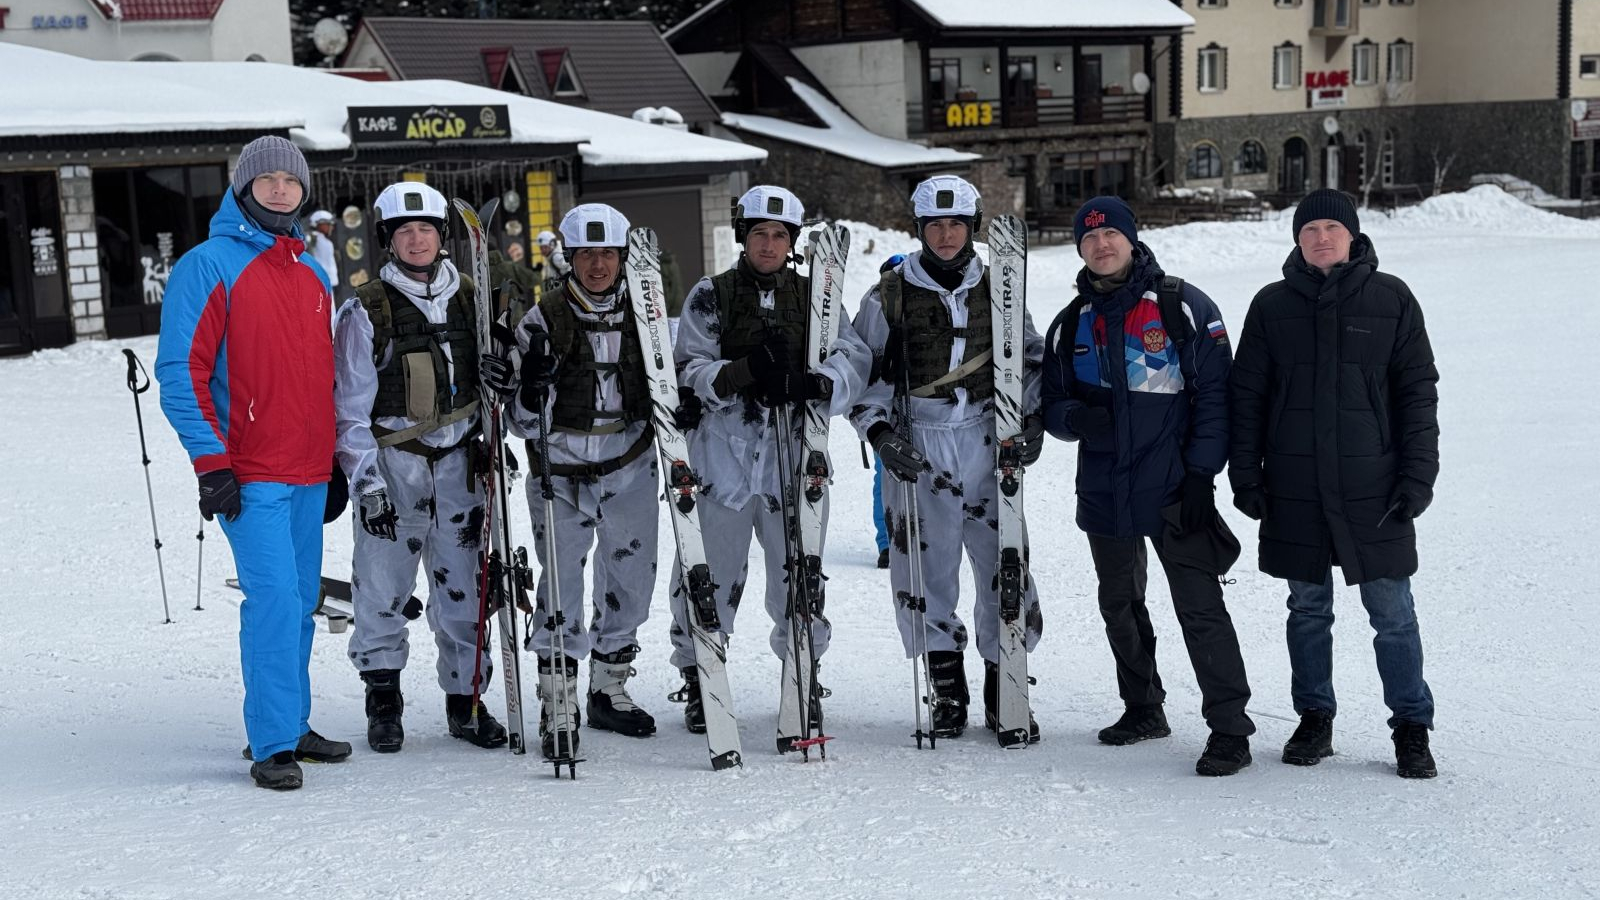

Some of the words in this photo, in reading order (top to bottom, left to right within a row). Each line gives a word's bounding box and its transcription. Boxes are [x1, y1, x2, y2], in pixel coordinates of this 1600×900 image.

[1306, 70, 1350, 89] КАФЕ
[358, 117, 397, 132] КАФЕ
[947, 103, 993, 127] АЯЗ
[406, 117, 466, 139] АНСАР
